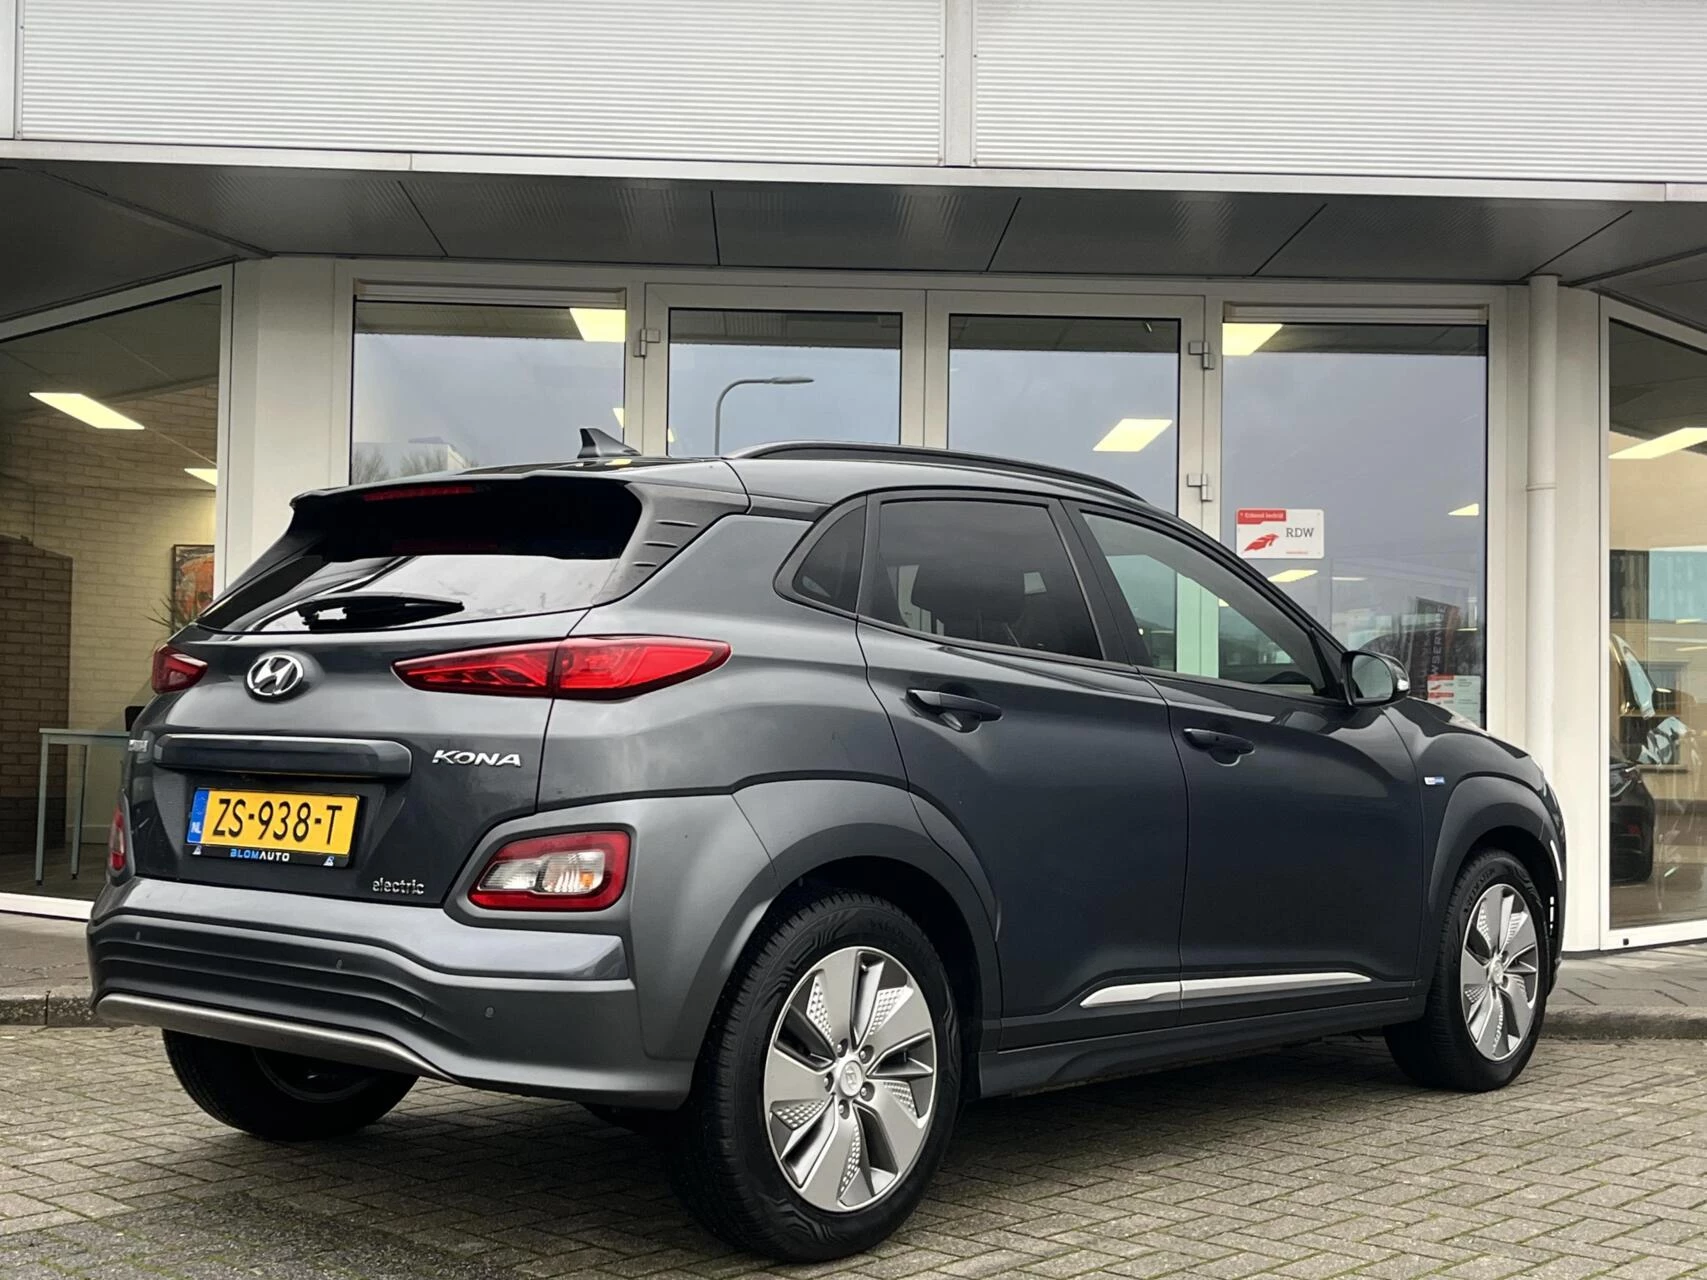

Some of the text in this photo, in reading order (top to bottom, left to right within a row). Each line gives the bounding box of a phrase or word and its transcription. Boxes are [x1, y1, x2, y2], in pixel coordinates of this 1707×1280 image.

[1285, 527, 1315, 538] RDW
[432, 749, 521, 767] KONA
[190, 821, 202, 834] NL
[212, 798, 343, 845] ZS-938-T
[372, 877, 425, 895] electric
